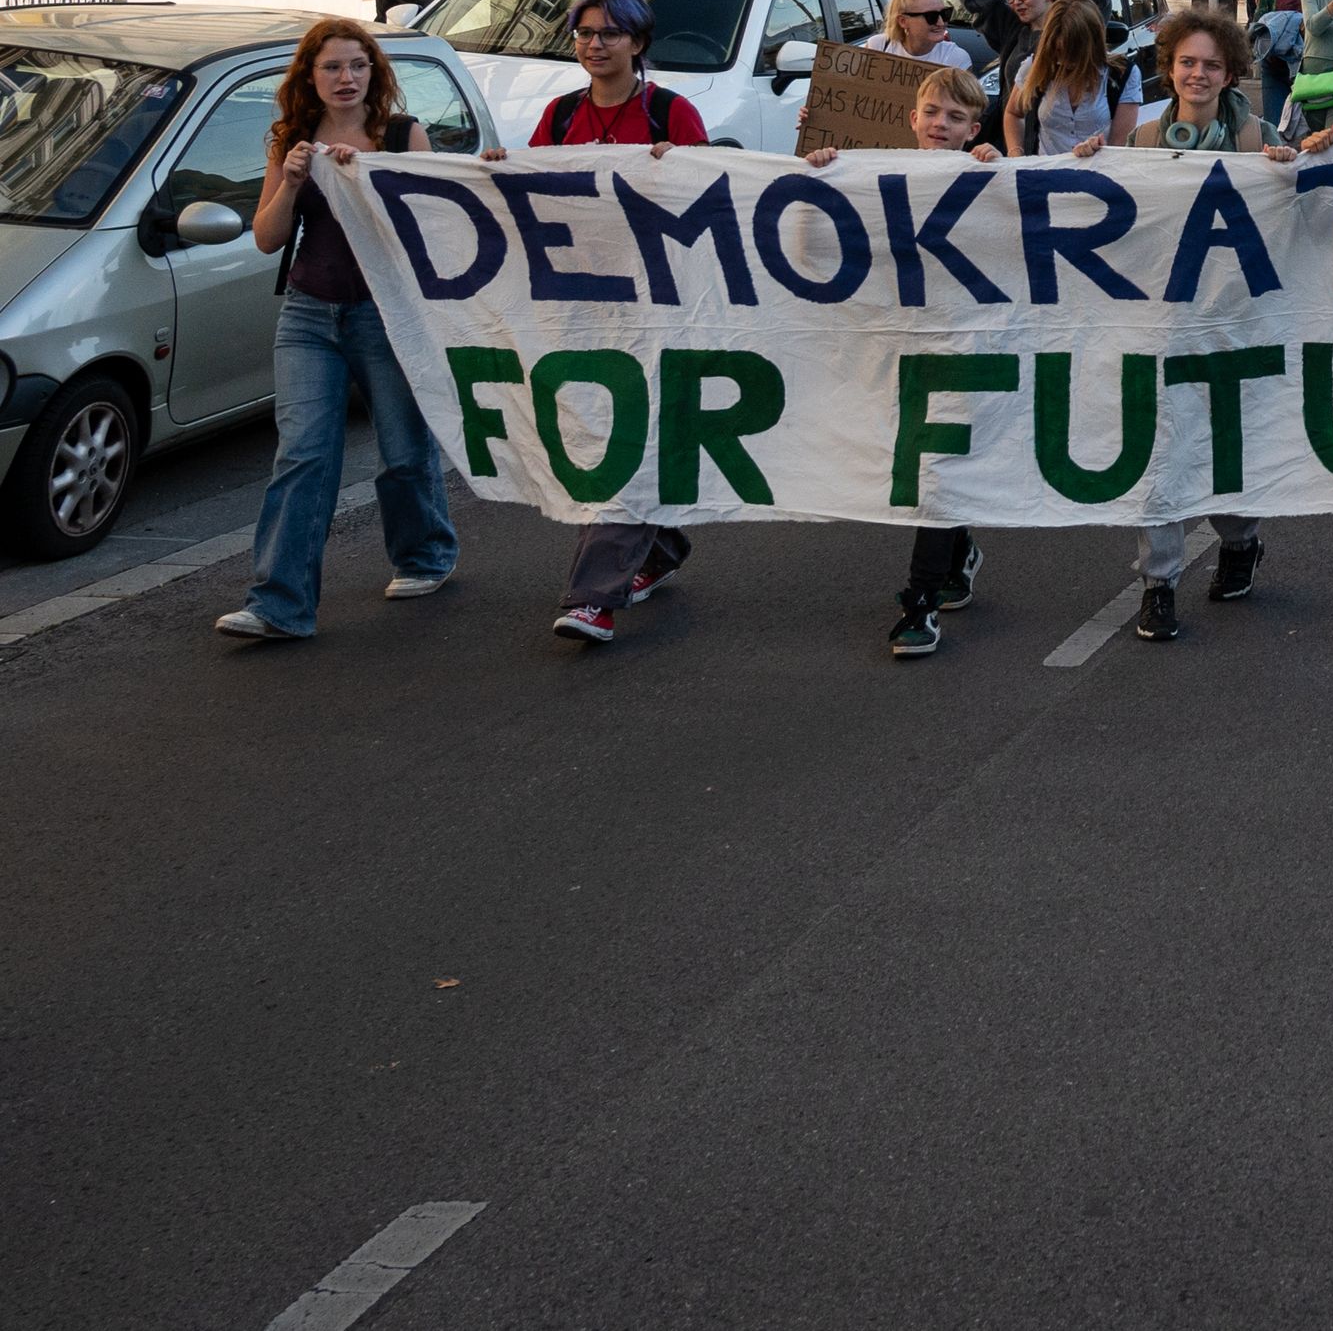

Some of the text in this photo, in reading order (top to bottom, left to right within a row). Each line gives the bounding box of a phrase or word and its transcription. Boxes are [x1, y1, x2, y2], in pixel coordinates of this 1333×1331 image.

[817, 45, 834, 71] 5
[835, 50, 878, 81] GUTE
[808, 85, 905, 128] DAS KLIMA
[446, 346, 786, 506] FOR
